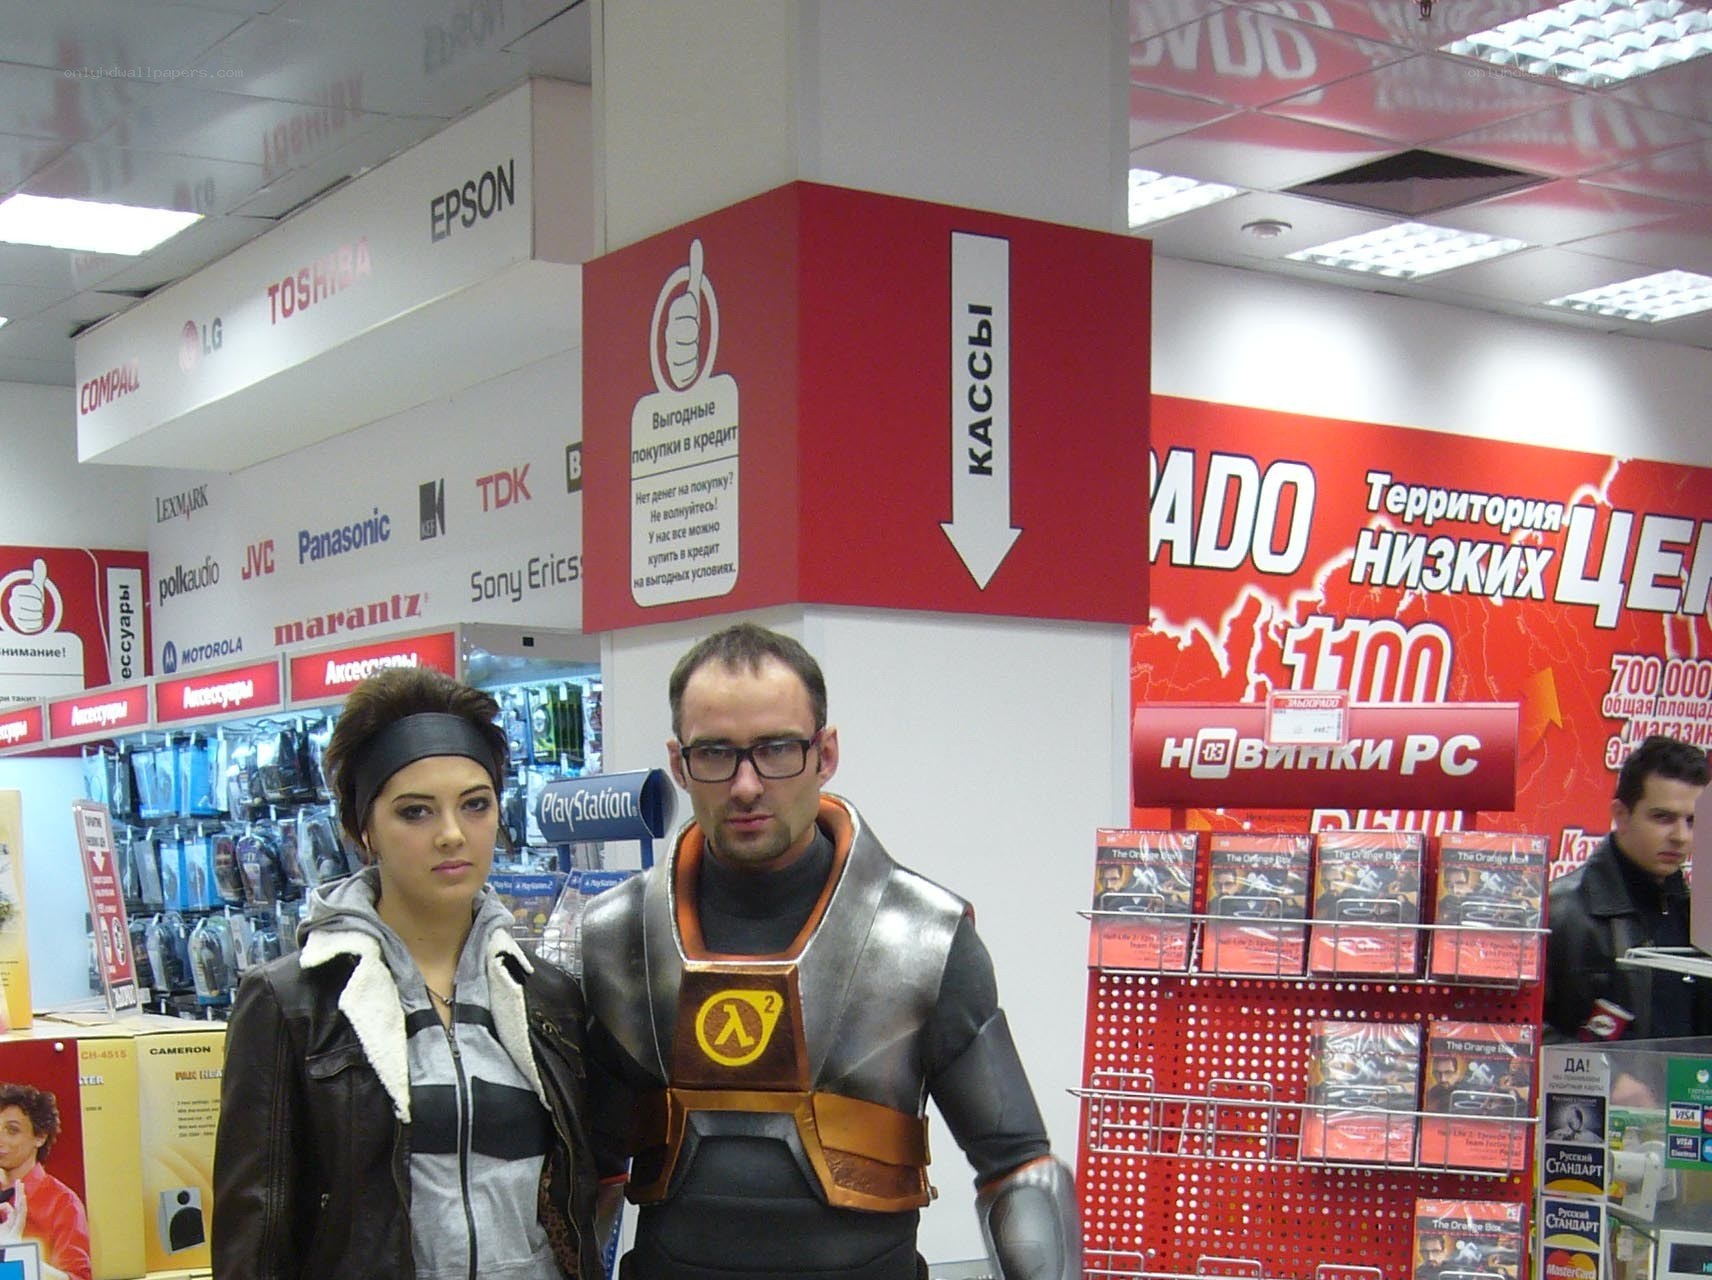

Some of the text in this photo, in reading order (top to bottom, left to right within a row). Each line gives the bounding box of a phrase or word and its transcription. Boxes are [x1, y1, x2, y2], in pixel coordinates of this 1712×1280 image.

[430, 159, 515, 244] EPSON
[267, 234, 372, 326] TOSHIBA
[202, 317, 223, 355] LG
[967, 303, 993, 477] КАССЫ
[652, 400, 715, 430] Выгодные
[632, 425, 738, 464] покупки в кредит
[476, 463, 532, 513] TDK
[636, 471, 734, 504] Нет денег на покупку?
[1365, 469, 1564, 533] Территория
[156, 484, 209, 524] LEXMARK
[650, 497, 718, 522] Не волнуйтесь!
[1149, 444, 1317, 577] ADO
[298, 507, 391, 564] Panasonic
[656, 529, 670, 542] нас
[672, 527, 686, 540] все
[689, 521, 720, 537] можно
[241, 538, 275, 581] JVC
[648, 551, 678, 568] купить
[687, 543, 720, 560] кредит
[158, 555, 220, 607] polkaudio
[471, 553, 582, 603] Sony Erics
[633, 576, 644, 588] на
[646, 570, 690, 588] выгодных
[273, 592, 422, 646] marantz
[0, 647, 66, 659] нимание!
[181, 636, 244, 665] MOTOROLA
[1612, 655, 1661, 696] 700
[1603, 694, 1653, 717] общая
[541, 786, 633, 832] PlayStation
[81, 1050, 127, 1061] CH-4515
[150, 1046, 211, 1056] CAMERON
[1446, 1041, 1463, 1050] The
[1464, 1042, 1495, 1054] Orange
[1564, 1057, 1590, 1072] ДА!
[1675, 1109, 1695, 1120] VISA
[1560, 1151, 1592, 1163] Русский
[1432, 1219, 1449, 1229] The
[1558, 1207, 1589, 1219] Русский
[1546, 1264, 1597, 1280] MasterCard
